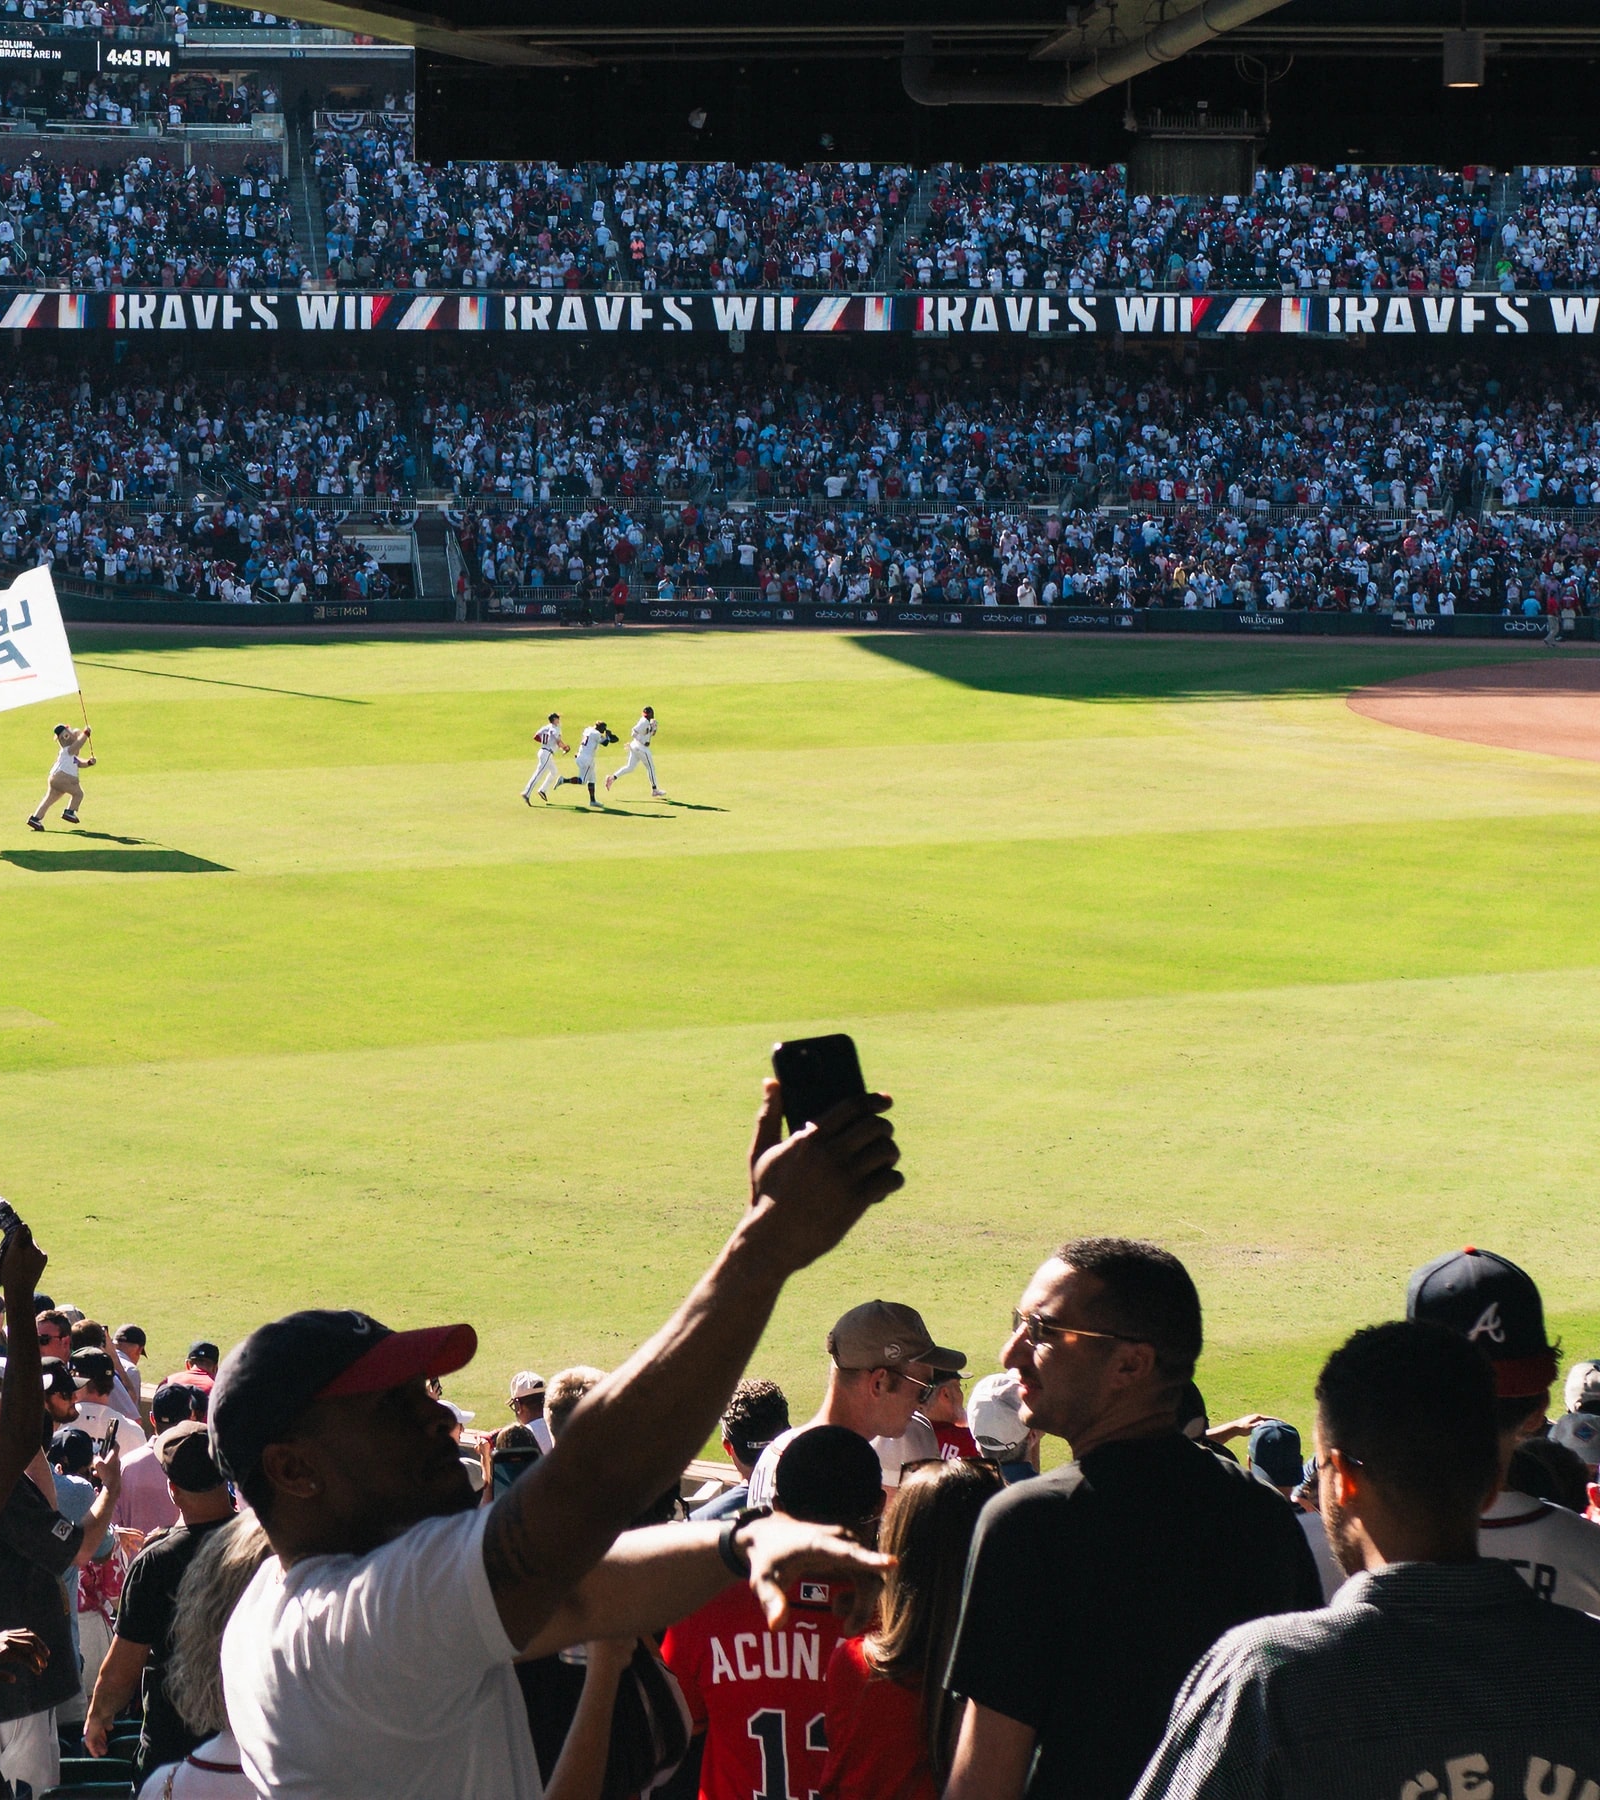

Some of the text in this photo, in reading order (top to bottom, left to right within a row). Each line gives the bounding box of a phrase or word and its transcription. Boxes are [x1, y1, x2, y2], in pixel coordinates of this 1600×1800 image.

[0, 49, 32, 58] BRAVES
[33, 50, 50, 59] ARE
[52, 50, 62, 59] IN
[106, 49, 170, 68] 4:43 PM
[1416, 618, 1435, 631] APP
[1504, 620, 1551, 631] abbvi
[710, 1621, 846, 1685] ACUÑ
